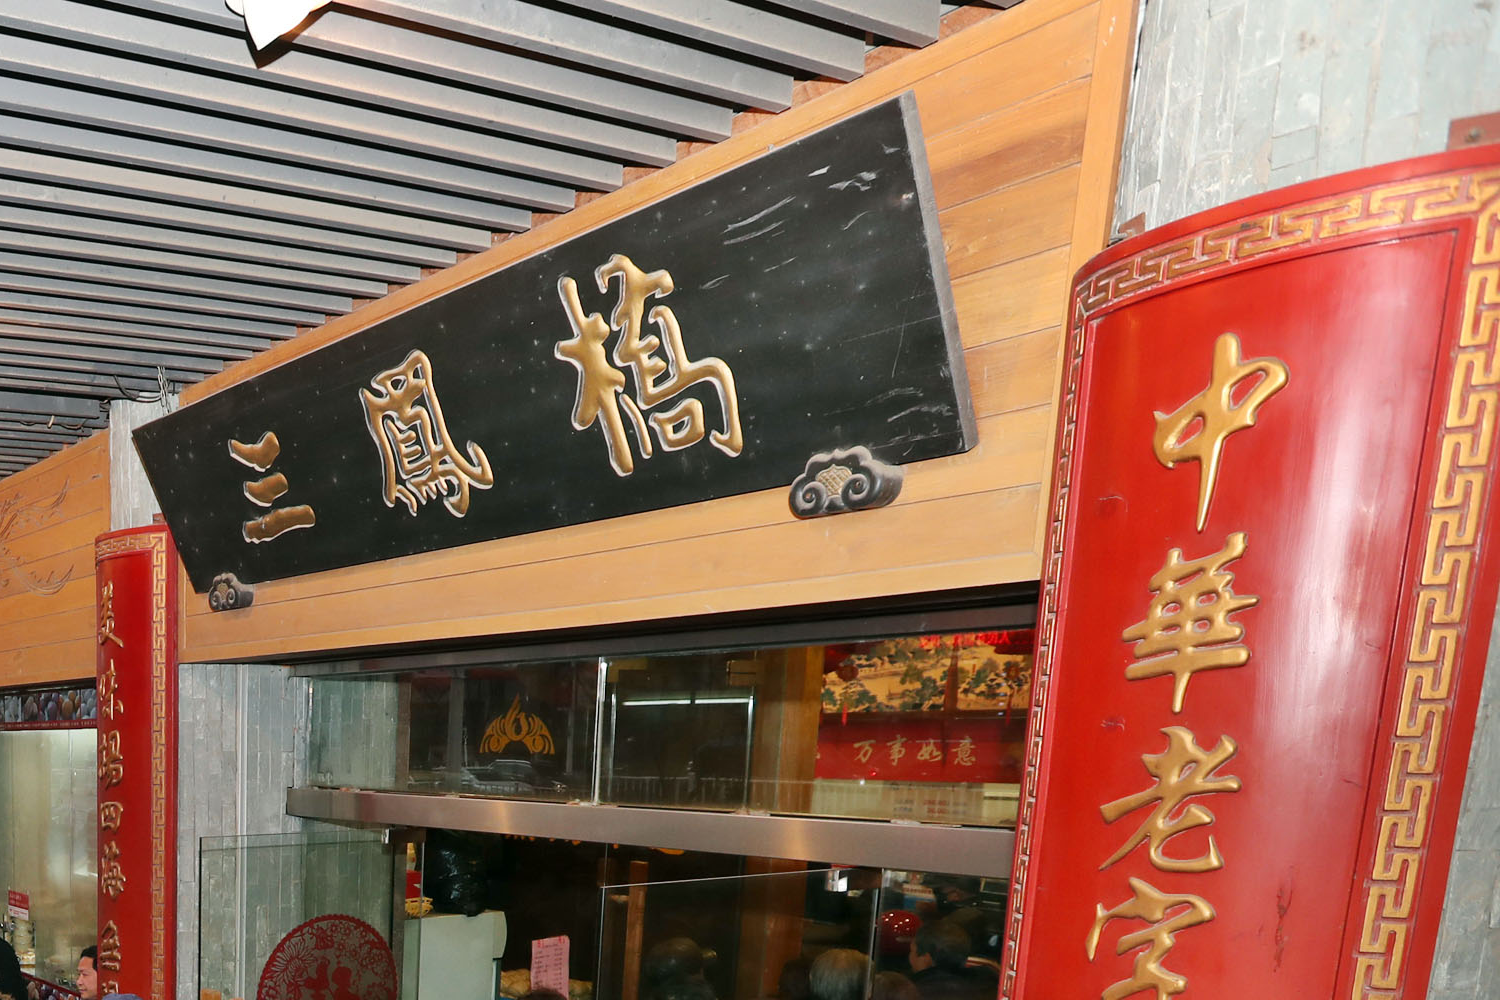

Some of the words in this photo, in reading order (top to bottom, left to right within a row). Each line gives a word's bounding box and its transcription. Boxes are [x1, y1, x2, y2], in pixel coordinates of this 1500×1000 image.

[228, 253, 744, 543] 三鳳橋
[853, 732, 977, 768] 万事如意
